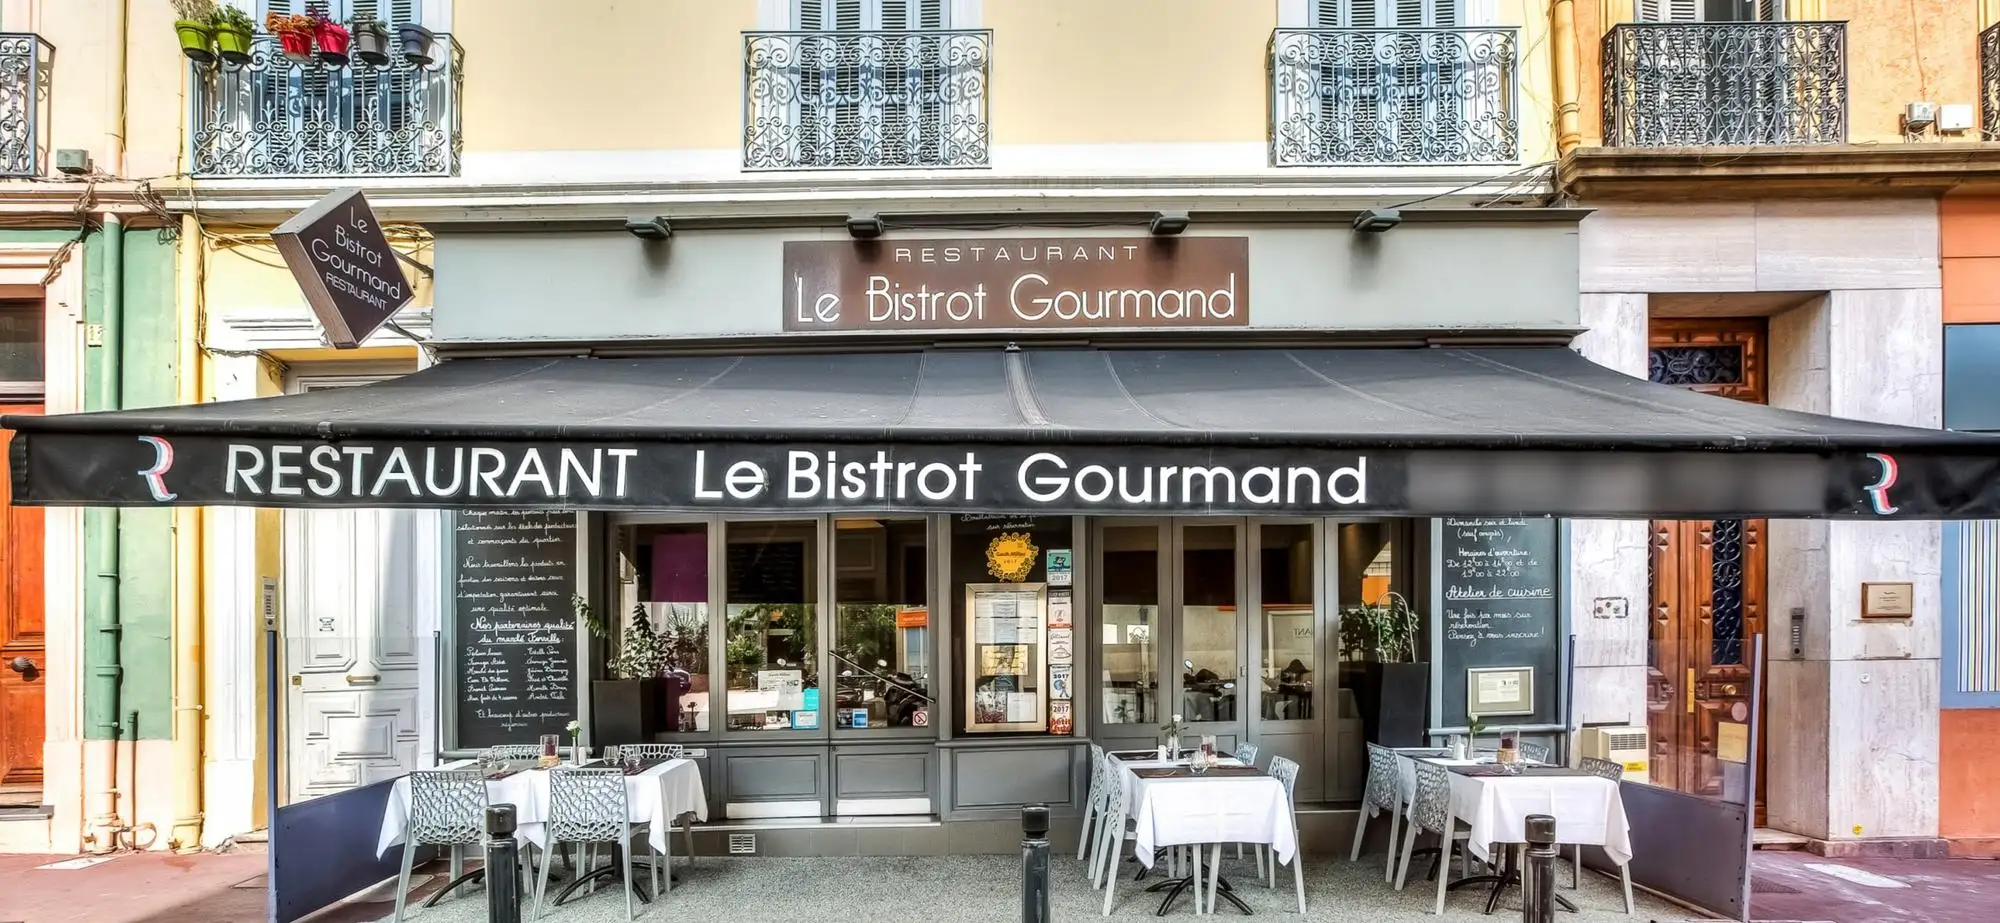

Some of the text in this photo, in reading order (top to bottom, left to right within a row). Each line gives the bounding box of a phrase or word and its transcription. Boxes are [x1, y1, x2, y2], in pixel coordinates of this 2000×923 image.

[350, 204, 368, 234] Le
[334, 224, 383, 268] Bistrot
[895, 245, 1138, 263] RESTAURANT
[311, 238, 401, 300] Gourmand
[325, 271, 388, 311] RESTAURANT
[794, 271, 1236, 323] Le Bistrot Gourmand
[224, 443, 639, 497] RESTAURANT
[694, 449, 764, 500] Le
[787, 449, 982, 500] Bistrot
[1016, 452, 1368, 504] Gourmand
[1458, 547, 1487, 557] Horaires
[462, 555, 481, 568] Nous
[1446, 559, 1460, 568] De
[1527, 558, 1539, 566] de
[1445, 584, 1553, 598] Atelier de cuisine
[487, 603, 515, 616] qualité
[1446, 609, 1460, 619] Une
[1462, 608, 1476, 624] fois
[1478, 610, 1491, 621] par
[470, 616, 576, 637] Nos partenaires qualité
[478, 633, 494, 643] du
[1447, 629, 1477, 647] Pensez
[1053, 705, 1069, 713] 2017
